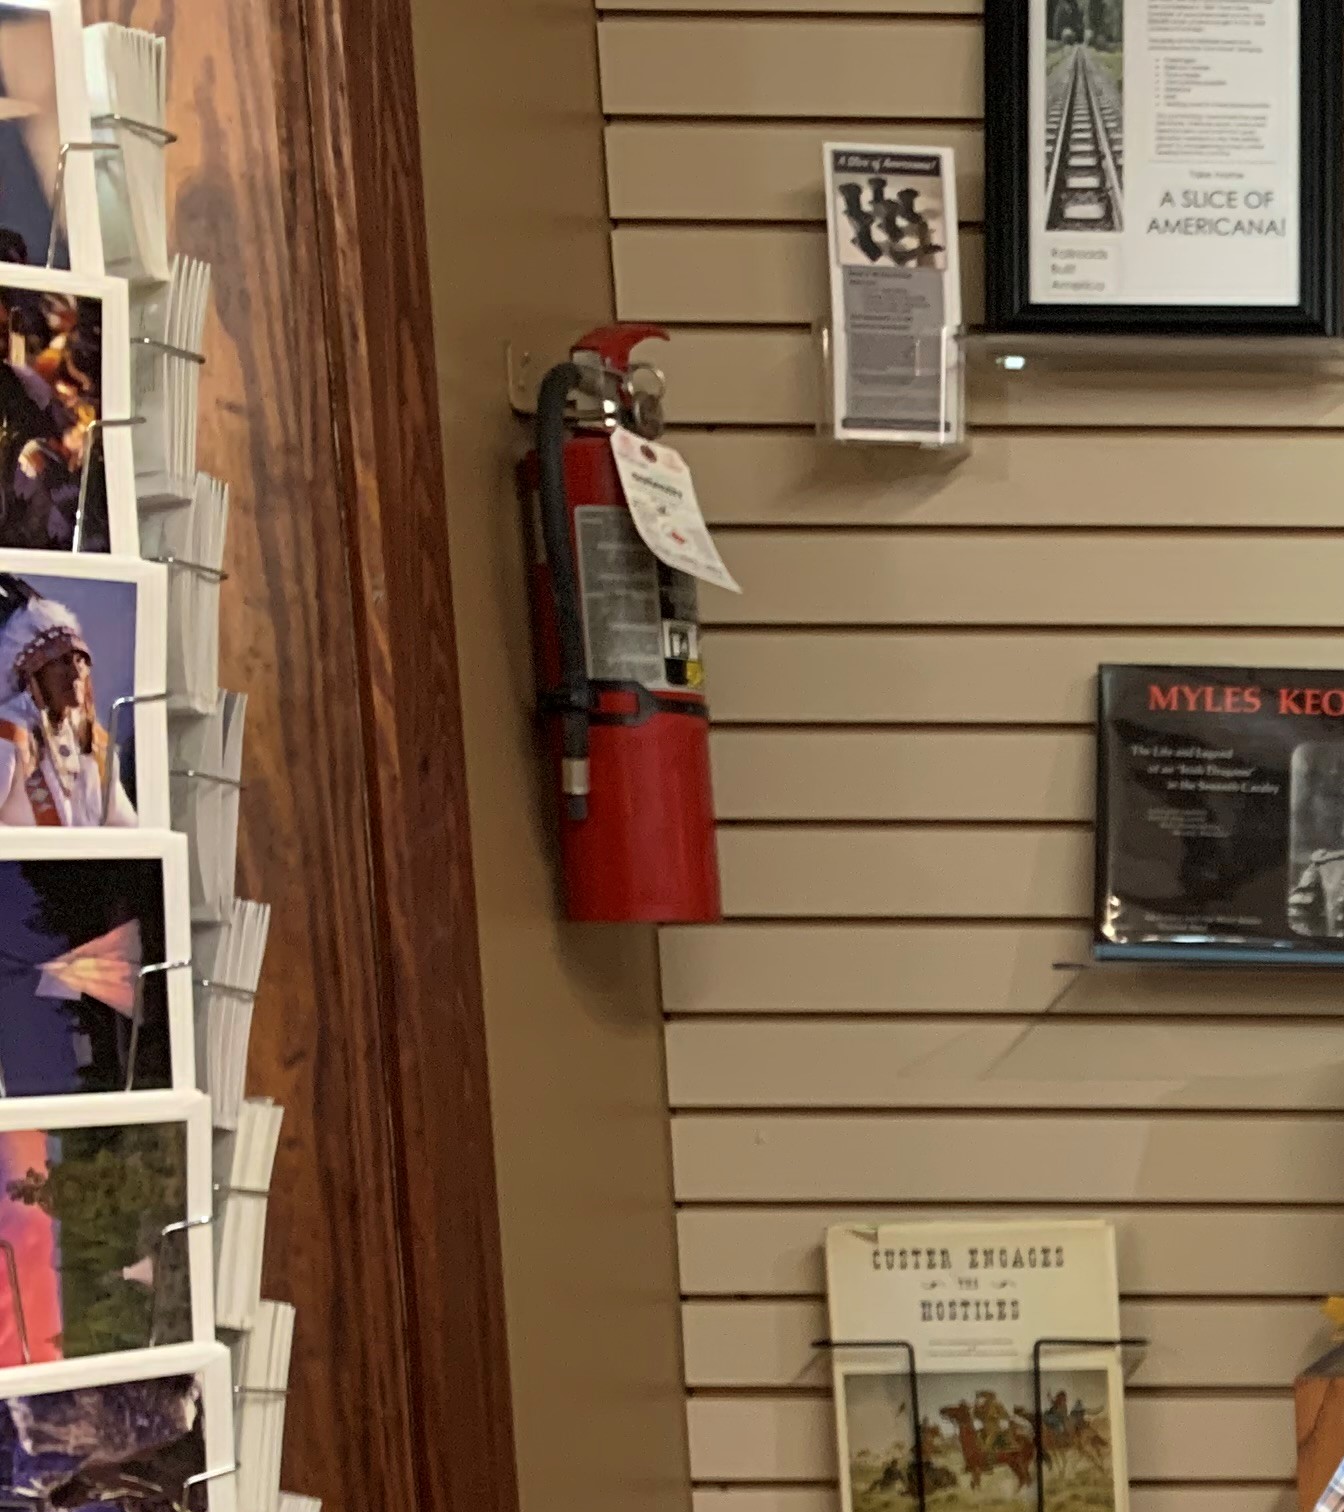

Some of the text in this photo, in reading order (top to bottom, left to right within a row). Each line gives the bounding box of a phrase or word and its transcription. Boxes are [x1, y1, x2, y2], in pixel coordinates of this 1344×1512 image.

[1160, 190, 1275, 209] A SLICE OF
[1147, 684, 1262, 713] MYLES
[872, 1246, 1066, 1271] CUSTER ENGAGES
[920, 1299, 1021, 1322] HOSTILES
